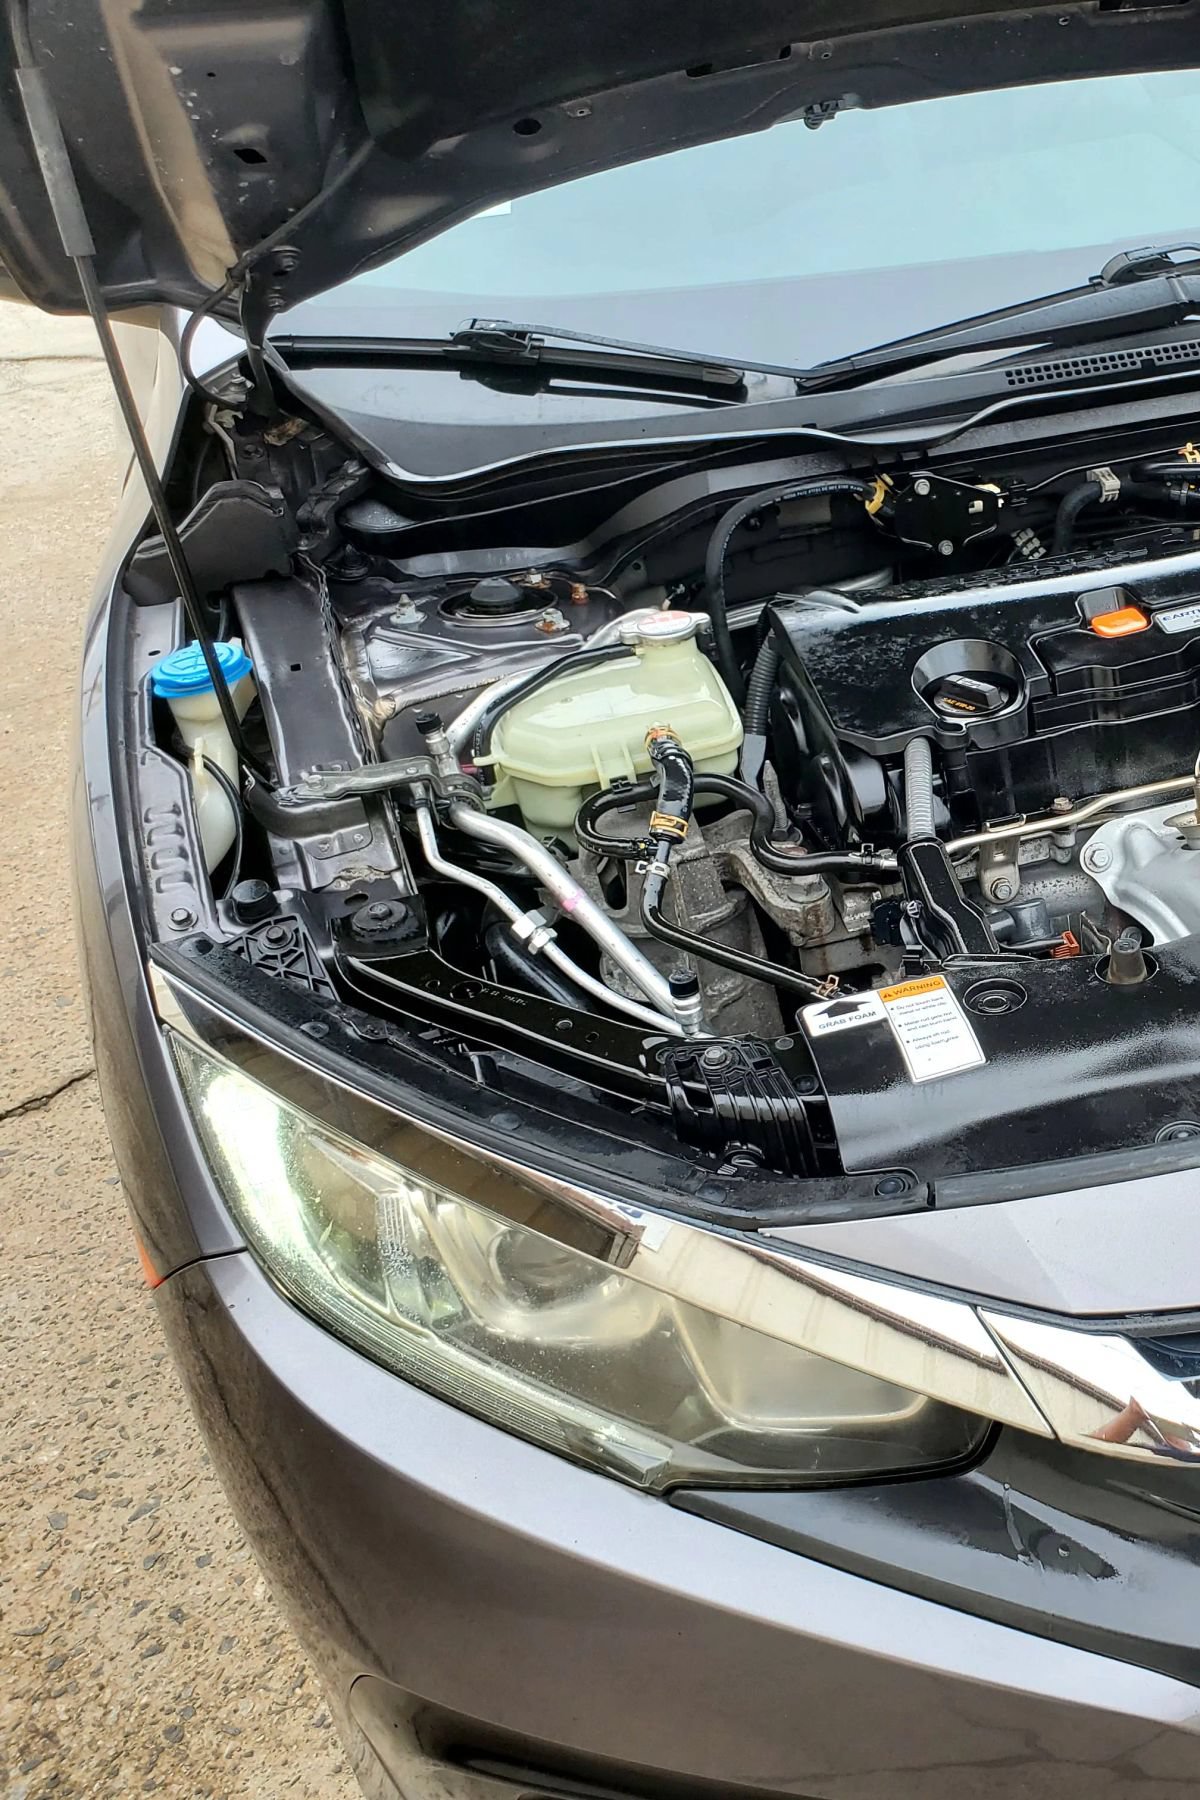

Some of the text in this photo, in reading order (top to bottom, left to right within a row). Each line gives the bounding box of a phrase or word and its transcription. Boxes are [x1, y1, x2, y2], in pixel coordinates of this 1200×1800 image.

[893, 980, 941, 995] WARNING
[818, 1011, 877, 1029] GRAB FOAM
